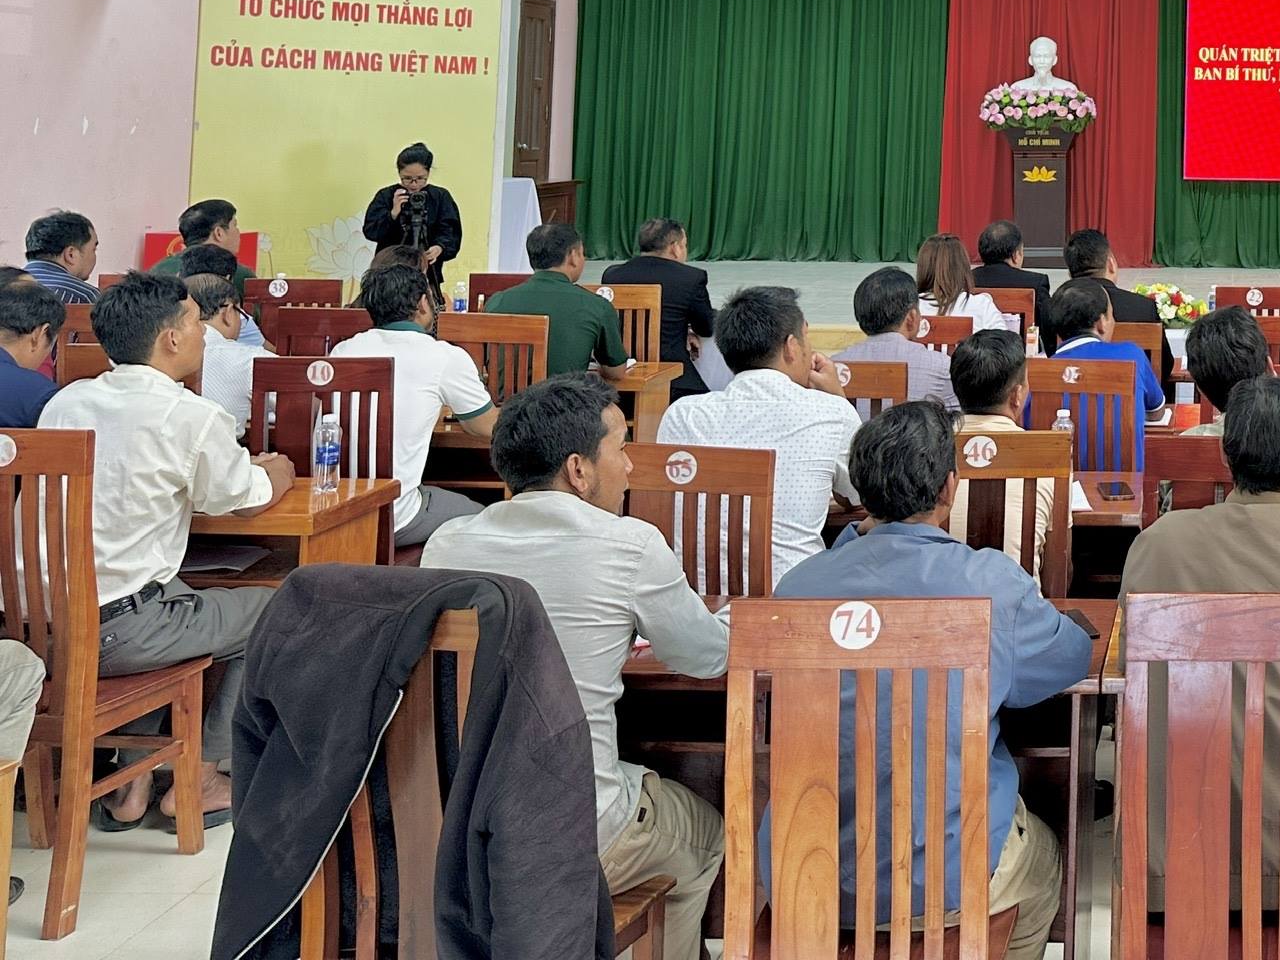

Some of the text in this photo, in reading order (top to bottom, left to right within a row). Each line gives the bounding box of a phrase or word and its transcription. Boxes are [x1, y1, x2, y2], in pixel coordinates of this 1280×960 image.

[332, 1, 369, 26] MỌI
[444, 8, 472, 31] LỢI
[210, 39, 253, 67] CỦA
[261, 44, 316, 70] CÁCH
[323, 50, 383, 75] MẠNG
[389, 50, 428, 77] VIỆT
[434, 55, 477, 75] NAM
[1194, 67, 1222, 80] BAN
[1226, 65, 1239, 80] BÍ
[1243, 66, 1276, 83] THƯ,
[273, 281, 286, 294] 38
[1249, 290, 1261, 302] 22
[310, 366, 331, 382] 10
[967, 439, 993, 462] 46
[835, 608, 875, 640] 74
